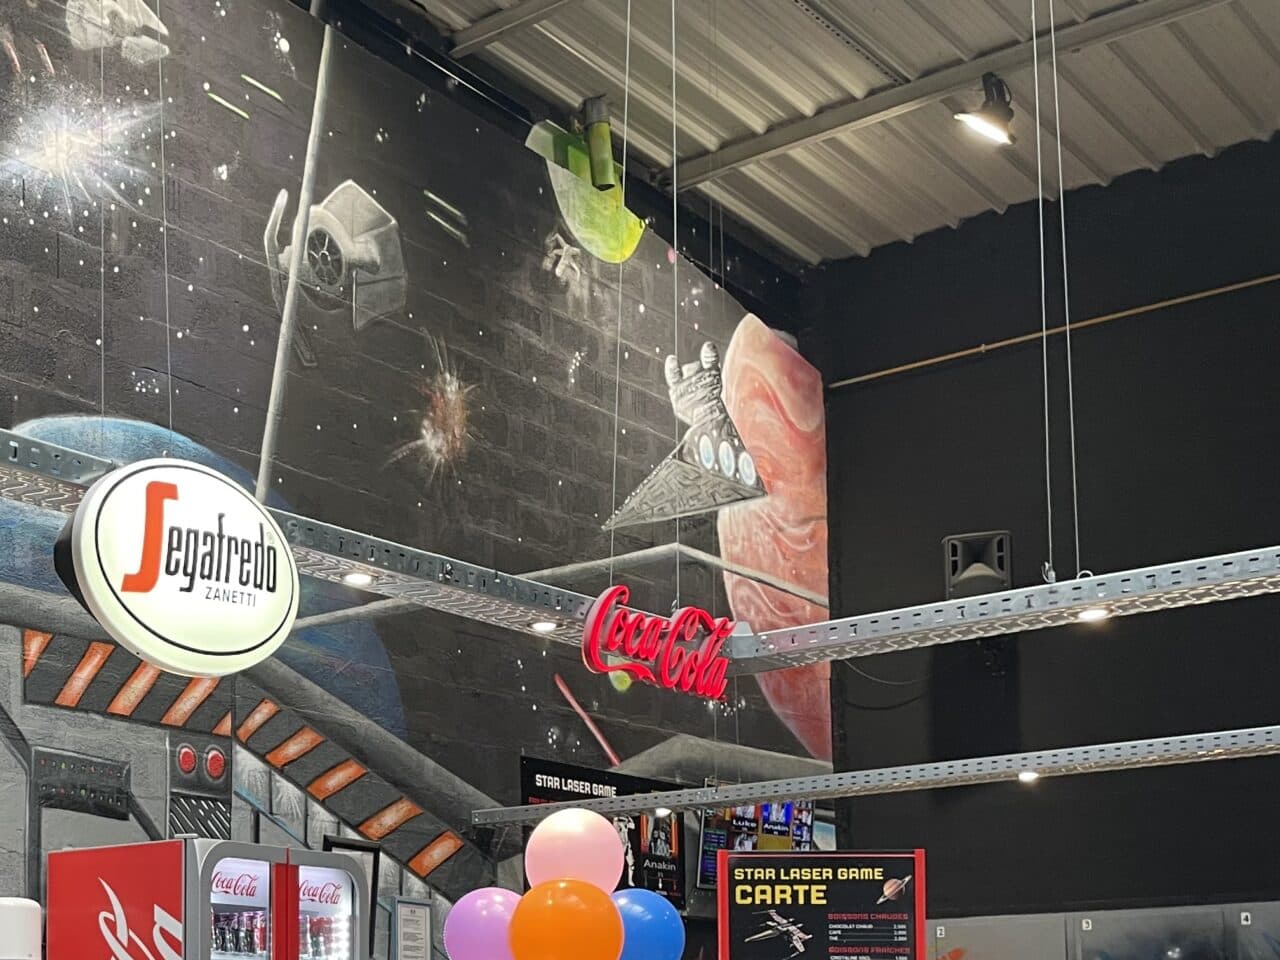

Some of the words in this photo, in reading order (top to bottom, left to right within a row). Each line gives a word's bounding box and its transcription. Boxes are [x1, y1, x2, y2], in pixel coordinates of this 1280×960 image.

[121, 480, 277, 593] Segafredo
[205, 586, 256, 607] ZANETTI
[582, 584, 736, 698] Coca-Cola
[535, 774, 560, 790] STAR
[561, 778, 591, 794] LASER
[592, 783, 617, 798] GAME
[643, 859, 676, 871] Anakin
[734, 868, 775, 880] STAR
[780, 868, 833, 880] LASER
[837, 868, 884, 880] GAME
[735, 885, 827, 905] CARTE
